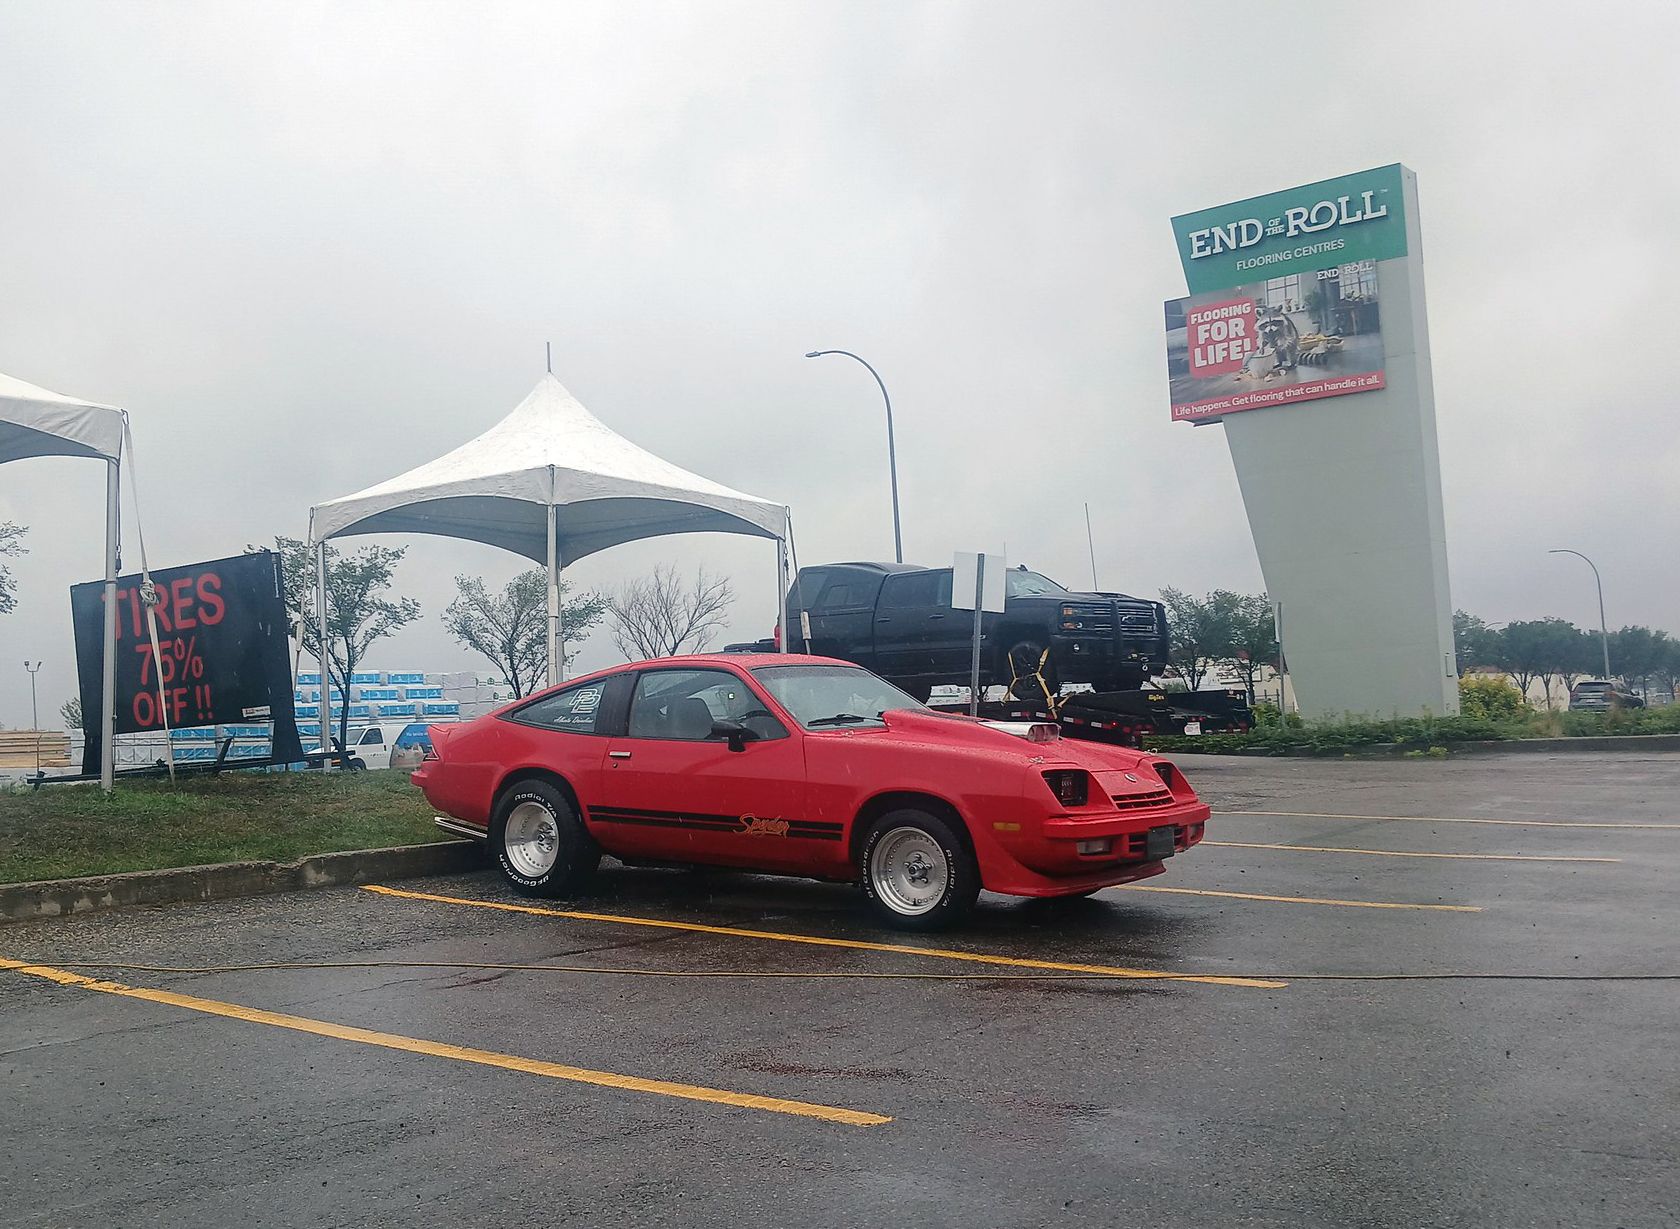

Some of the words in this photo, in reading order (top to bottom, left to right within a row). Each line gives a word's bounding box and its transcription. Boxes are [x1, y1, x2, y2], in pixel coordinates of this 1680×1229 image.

[1268, 218, 1281, 227] OF
[1285, 191, 1387, 237] ROLL
[1189, 219, 1263, 259] END
[1265, 224, 1285, 236] THE
[1236, 251, 1292, 271] FLOORING
[1294, 239, 1345, 258] CENTRES
[1317, 269, 1339, 280] END
[1344, 262, 1373, 275] ROLL
[1190, 303, 1251, 325] FLOORING
[1197, 318, 1245, 344] FOR
[1194, 338, 1251, 368] LIFE!
[1175, 406, 1191, 416] Life
[1191, 400, 1232, 414] happens.
[1232, 396, 1249, 406] Get
[1250, 391, 1284, 403] flooring
[1285, 387, 1304, 397] that
[1305, 386, 1323, 394] can
[1324, 379, 1357, 391] handle
[1358, 377, 1365, 386] it
[1366, 375, 1379, 385] all.
[102, 573, 225, 640] TIRES
[135, 636, 204, 686] 75%
